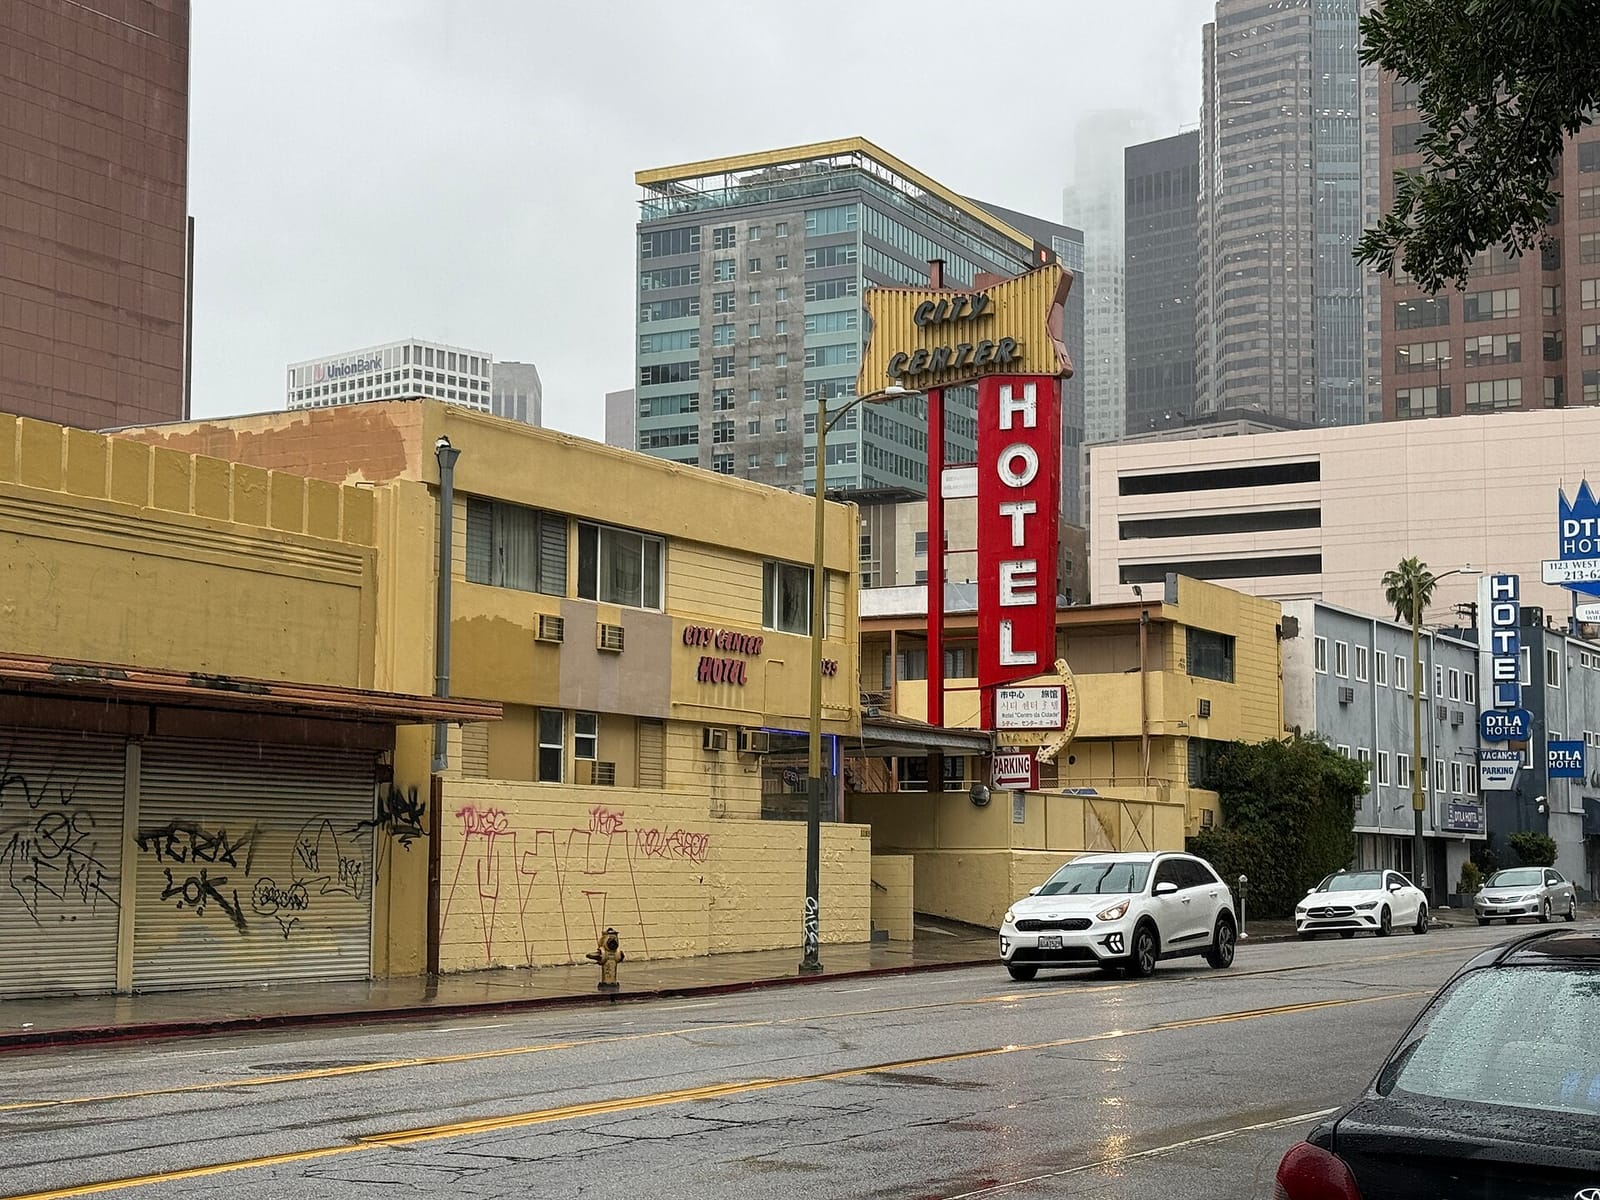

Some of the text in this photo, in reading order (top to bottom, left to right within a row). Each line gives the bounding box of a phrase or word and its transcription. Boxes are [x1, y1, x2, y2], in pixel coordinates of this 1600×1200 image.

[914, 293, 990, 326] CITY
[888, 336, 1018, 378] CENTER
[327, 356, 382, 378] UnionBank
[997, 381, 1039, 667] HOTEL
[1563, 519, 1600, 538] DT
[1549, 560, 1597, 570] 1123 WEST
[682, 625, 764, 656] CITY CENTER
[1491, 576, 1516, 708] HOTEL
[697, 656, 748, 686] HOTEL
[1000, 690, 1024, 699] 市中心
[1486, 715, 1522, 726] DTLA
[1486, 726, 1523, 735] HOTEL
[1481, 751, 1518, 760] VACANCY
[1548, 750, 1582, 760] DTLA
[994, 757, 1030, 774] PARKING
[1481, 766, 1514, 775] PARKING
[1548, 760, 1582, 768] HOTEL
